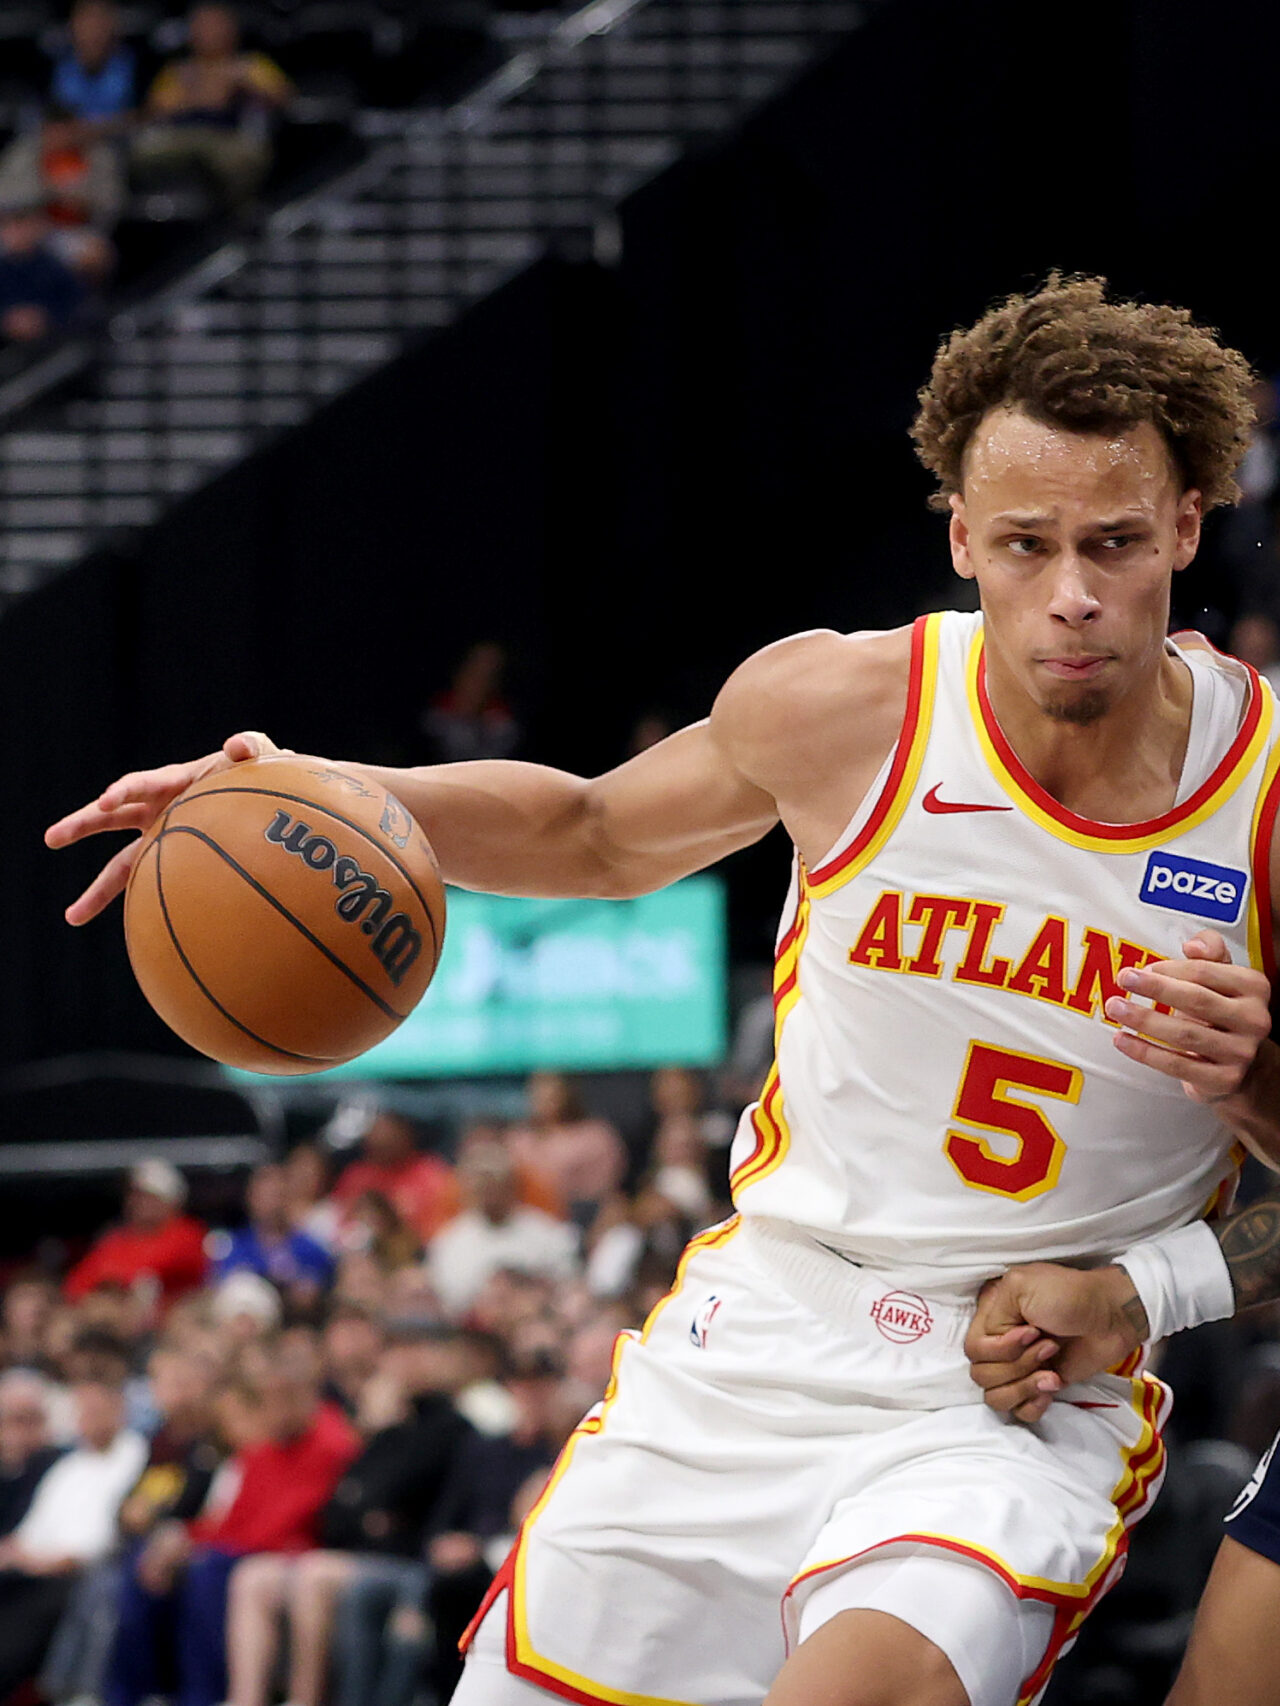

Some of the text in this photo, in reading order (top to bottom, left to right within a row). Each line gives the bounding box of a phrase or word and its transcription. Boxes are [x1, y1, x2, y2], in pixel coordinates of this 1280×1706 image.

[263, 809, 423, 987] Wilson
[1147, 865, 1237, 904] paze
[848, 890, 1175, 1047] ATLAN
[943, 1039, 1084, 1202] 5
[870, 1300, 934, 1334] HAWKS
